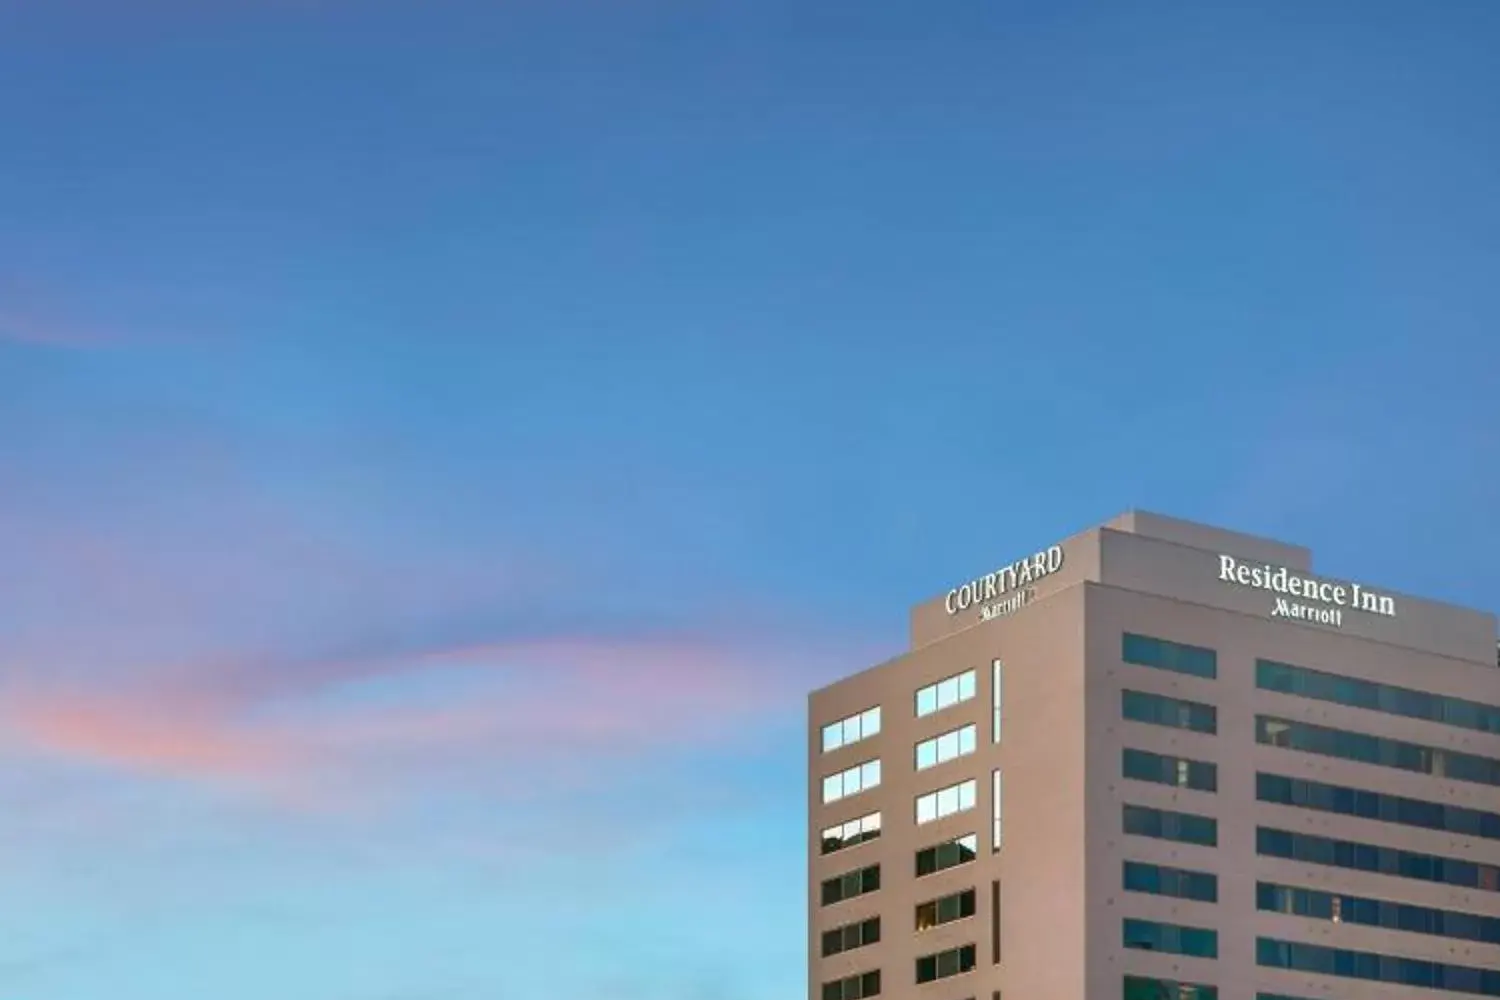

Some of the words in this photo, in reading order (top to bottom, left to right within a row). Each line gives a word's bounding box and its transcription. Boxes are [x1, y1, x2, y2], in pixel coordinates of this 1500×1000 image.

[944, 545, 1063, 615] COURTYARD
[1219, 554, 1346, 605] Residence
[1351, 583, 1396, 617] Inn
[1271, 597, 1342, 627] Marriott
